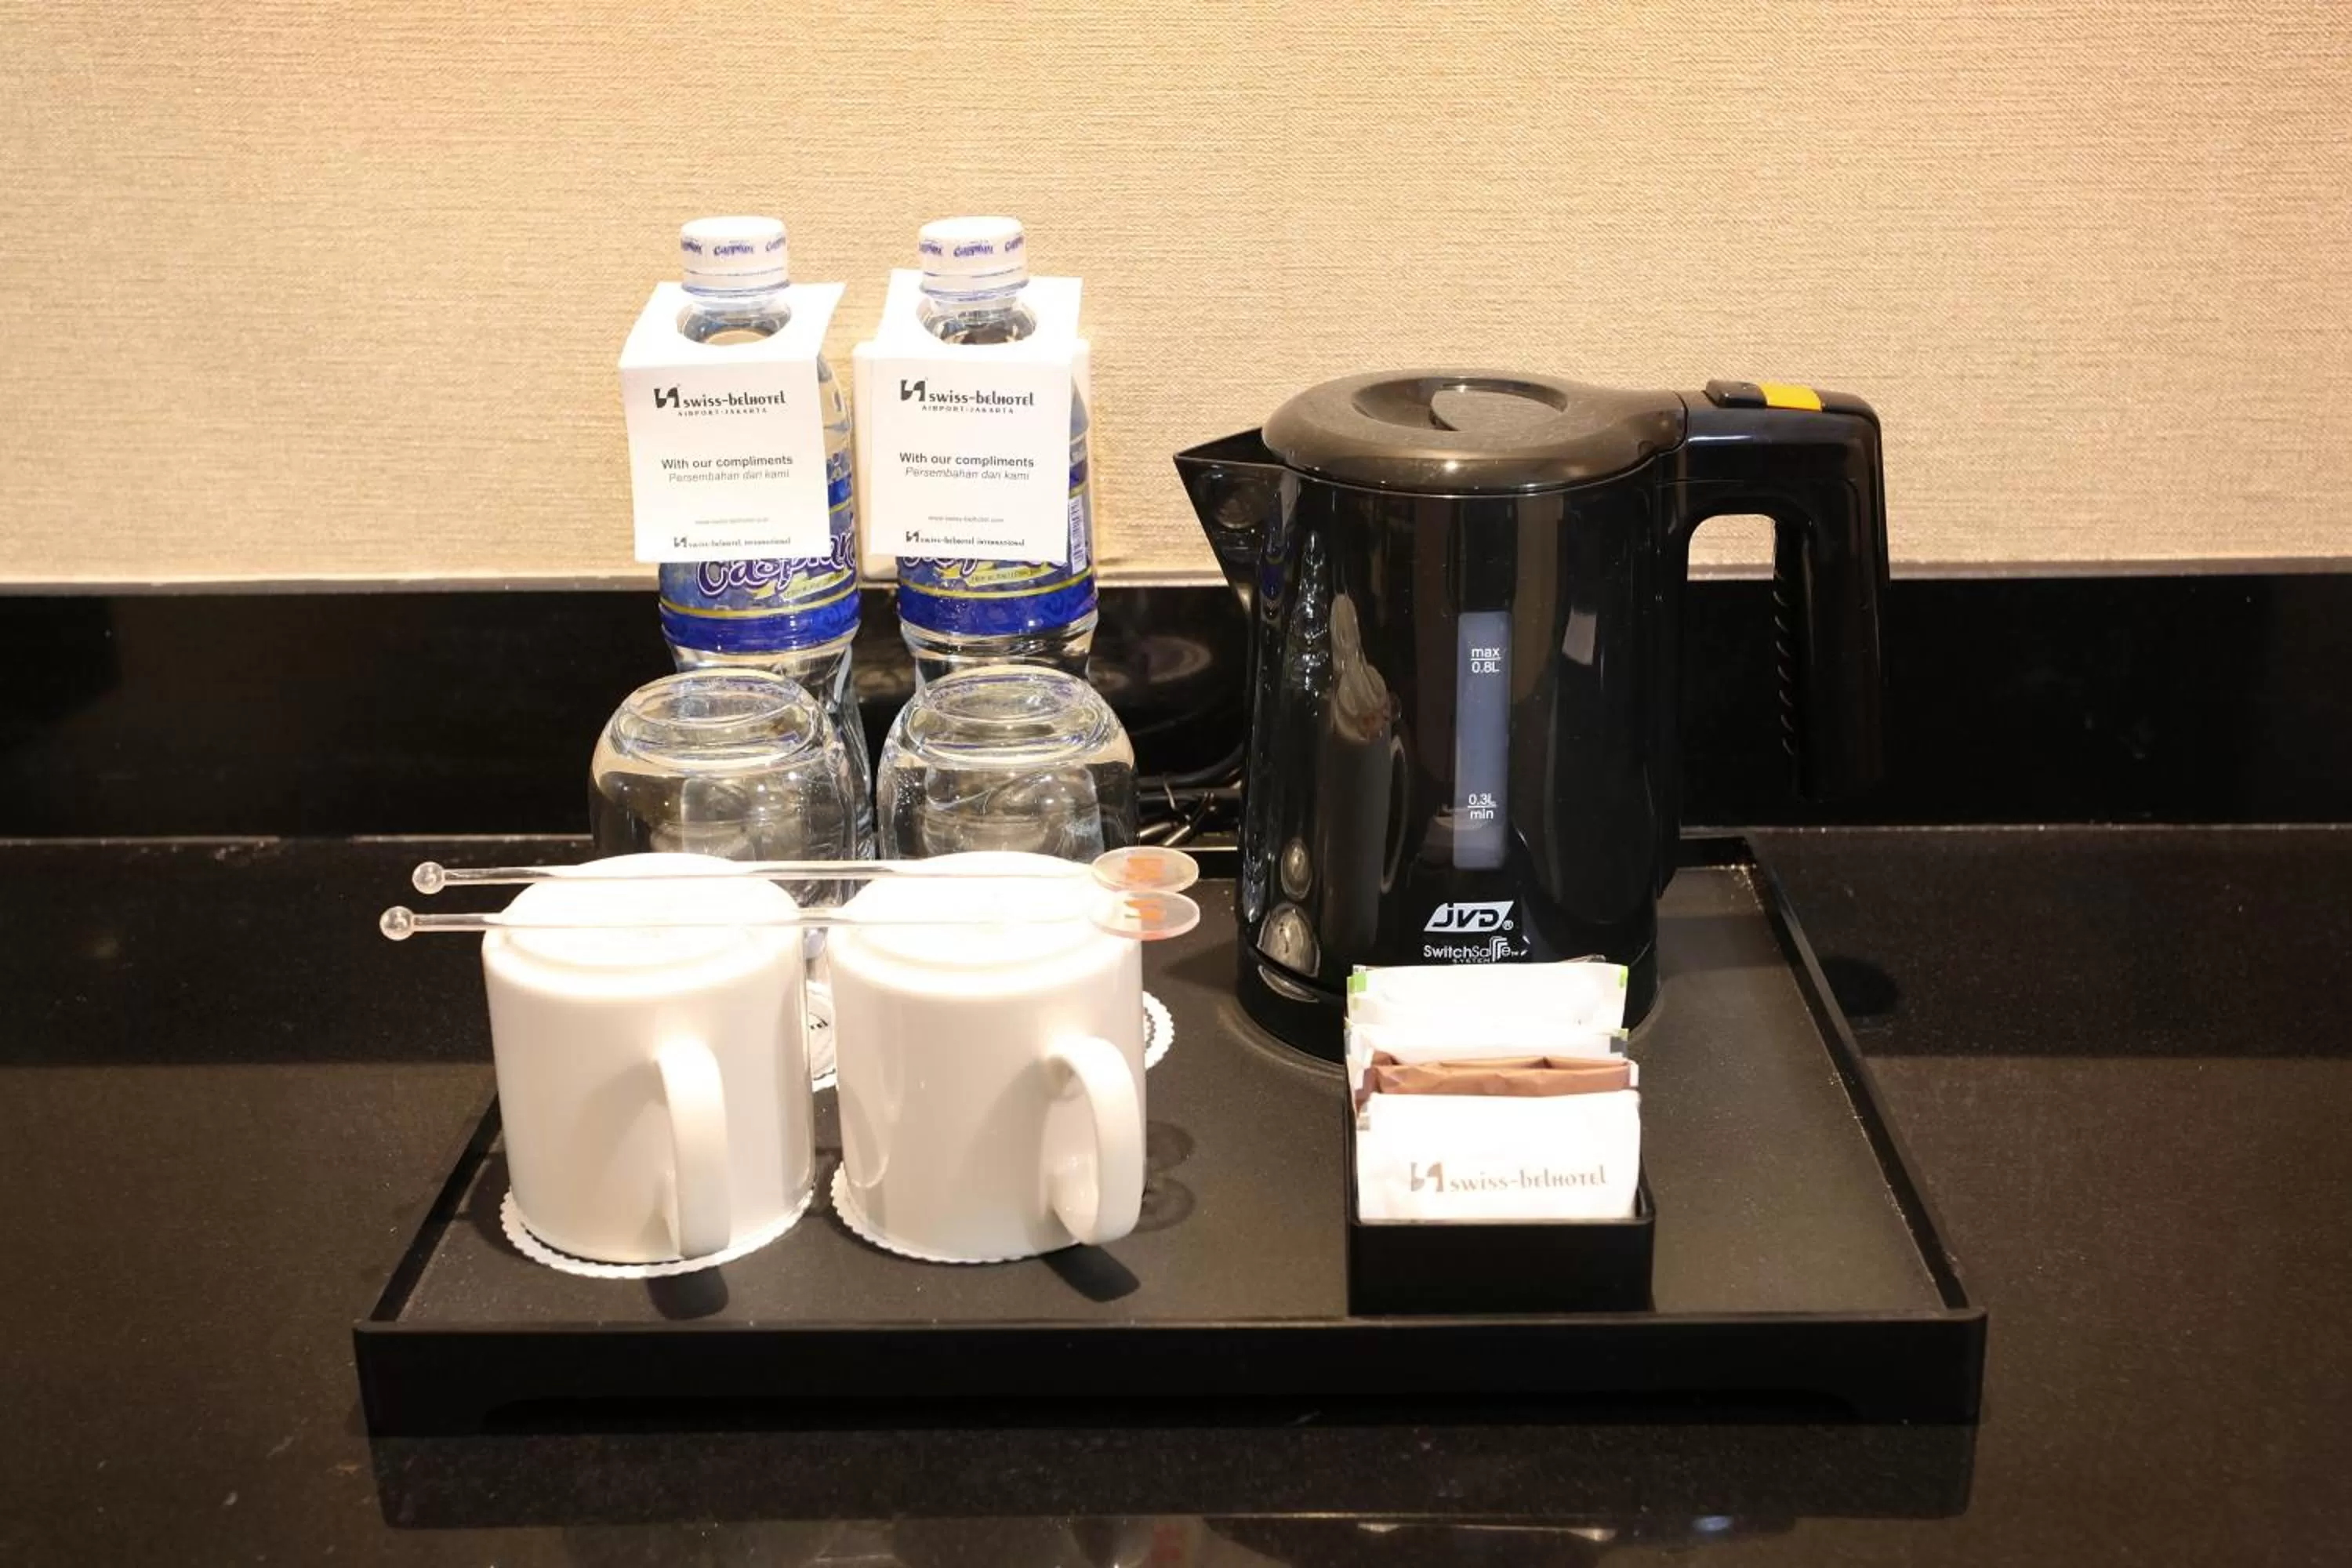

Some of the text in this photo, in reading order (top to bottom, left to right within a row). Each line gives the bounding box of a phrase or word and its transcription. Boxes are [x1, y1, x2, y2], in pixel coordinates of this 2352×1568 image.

[661, 455, 793, 470] With our compliments
[899, 452, 1034, 468] With our compliments
[765, 469, 790, 480] kami
[1004, 470, 1029, 481] kami
[1472, 648, 1500, 658] max
[1472, 661, 1500, 673] 0.8L
[1468, 793, 1497, 806] 0.3L
[1470, 808, 1494, 819] min
